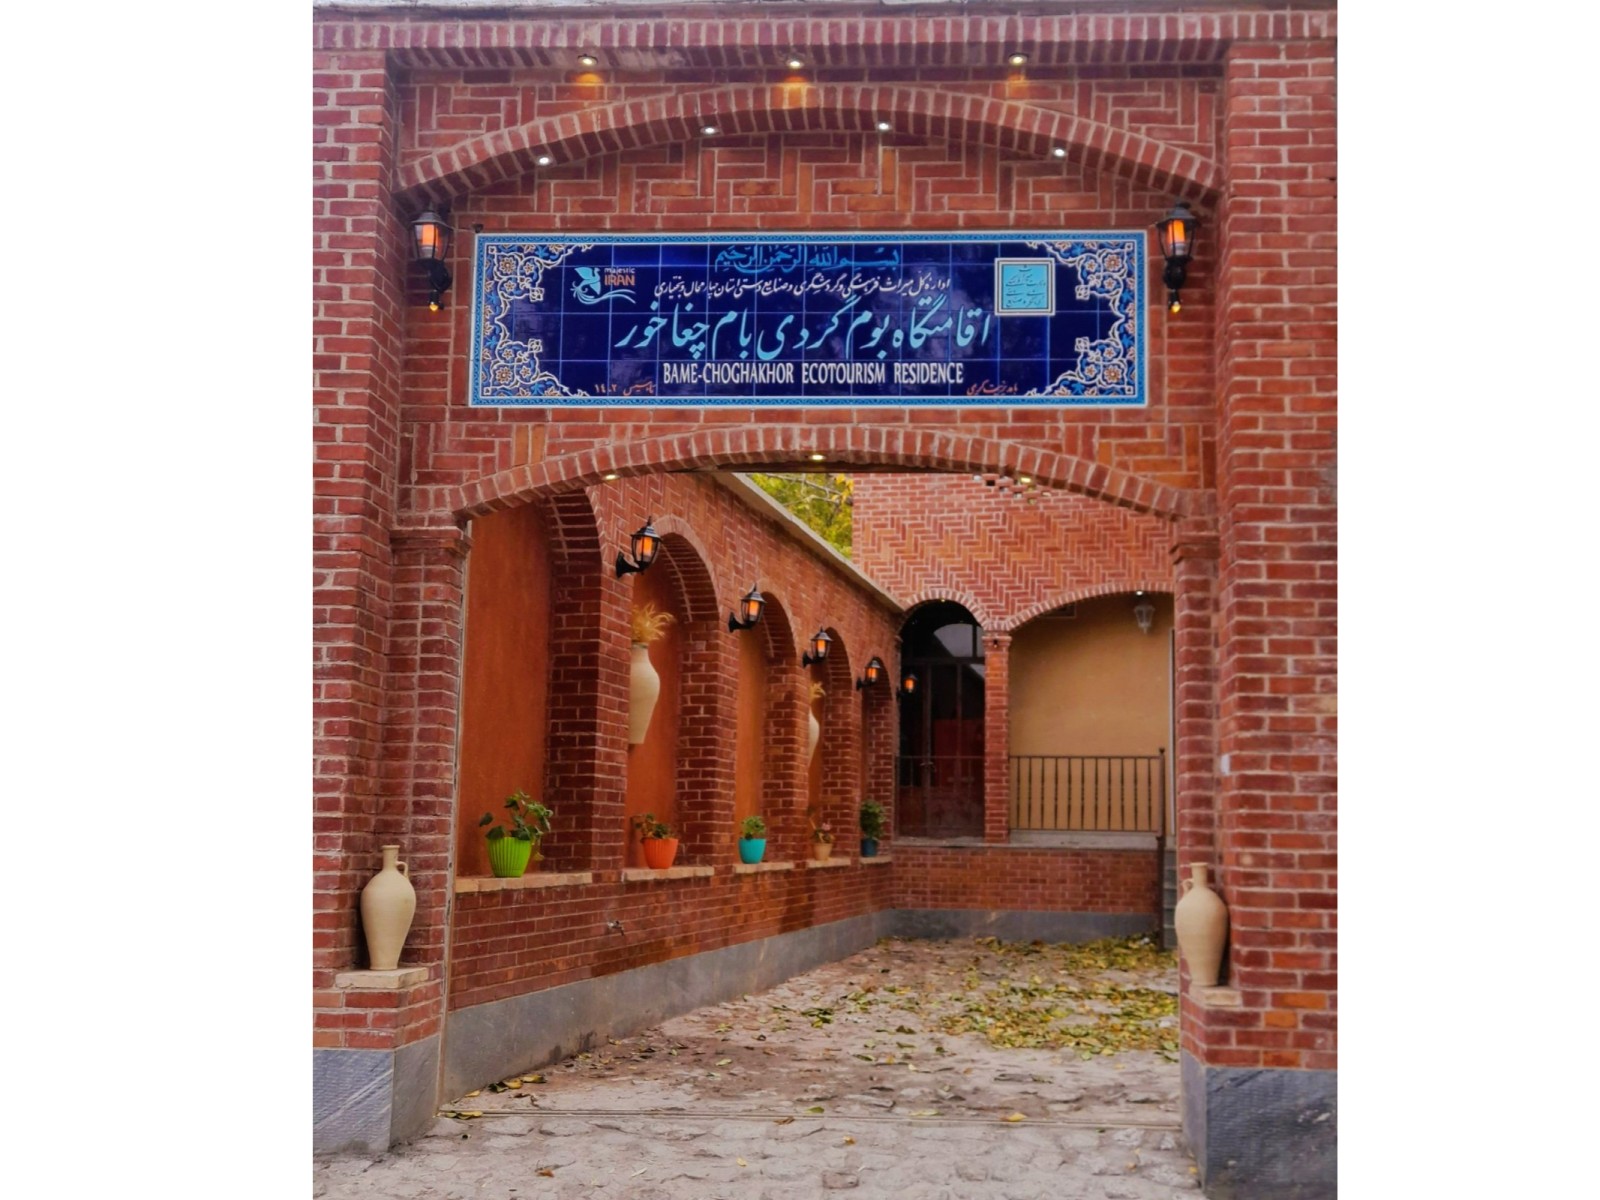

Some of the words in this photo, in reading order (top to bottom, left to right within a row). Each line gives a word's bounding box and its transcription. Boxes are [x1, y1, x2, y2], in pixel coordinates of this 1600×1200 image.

[604, 274, 636, 287] IRAN
[713, 277, 741, 298] استان
[733, 279, 764, 299] دستی
[761, 277, 790, 297] صنایع
[841, 272, 881, 298] فرهنگی
[878, 276, 915, 297] میراث
[756, 294, 862, 361] گردی
[892, 292, 991, 349] اقامتگاه
[711, 307, 753, 362] بام
[845, 309, 890, 361] بوم
[663, 362, 795, 384] BAME-CHOGHAKHOR
[801, 362, 886, 384] ECOTOURISM
[893, 362, 965, 385] RESIDENCE
